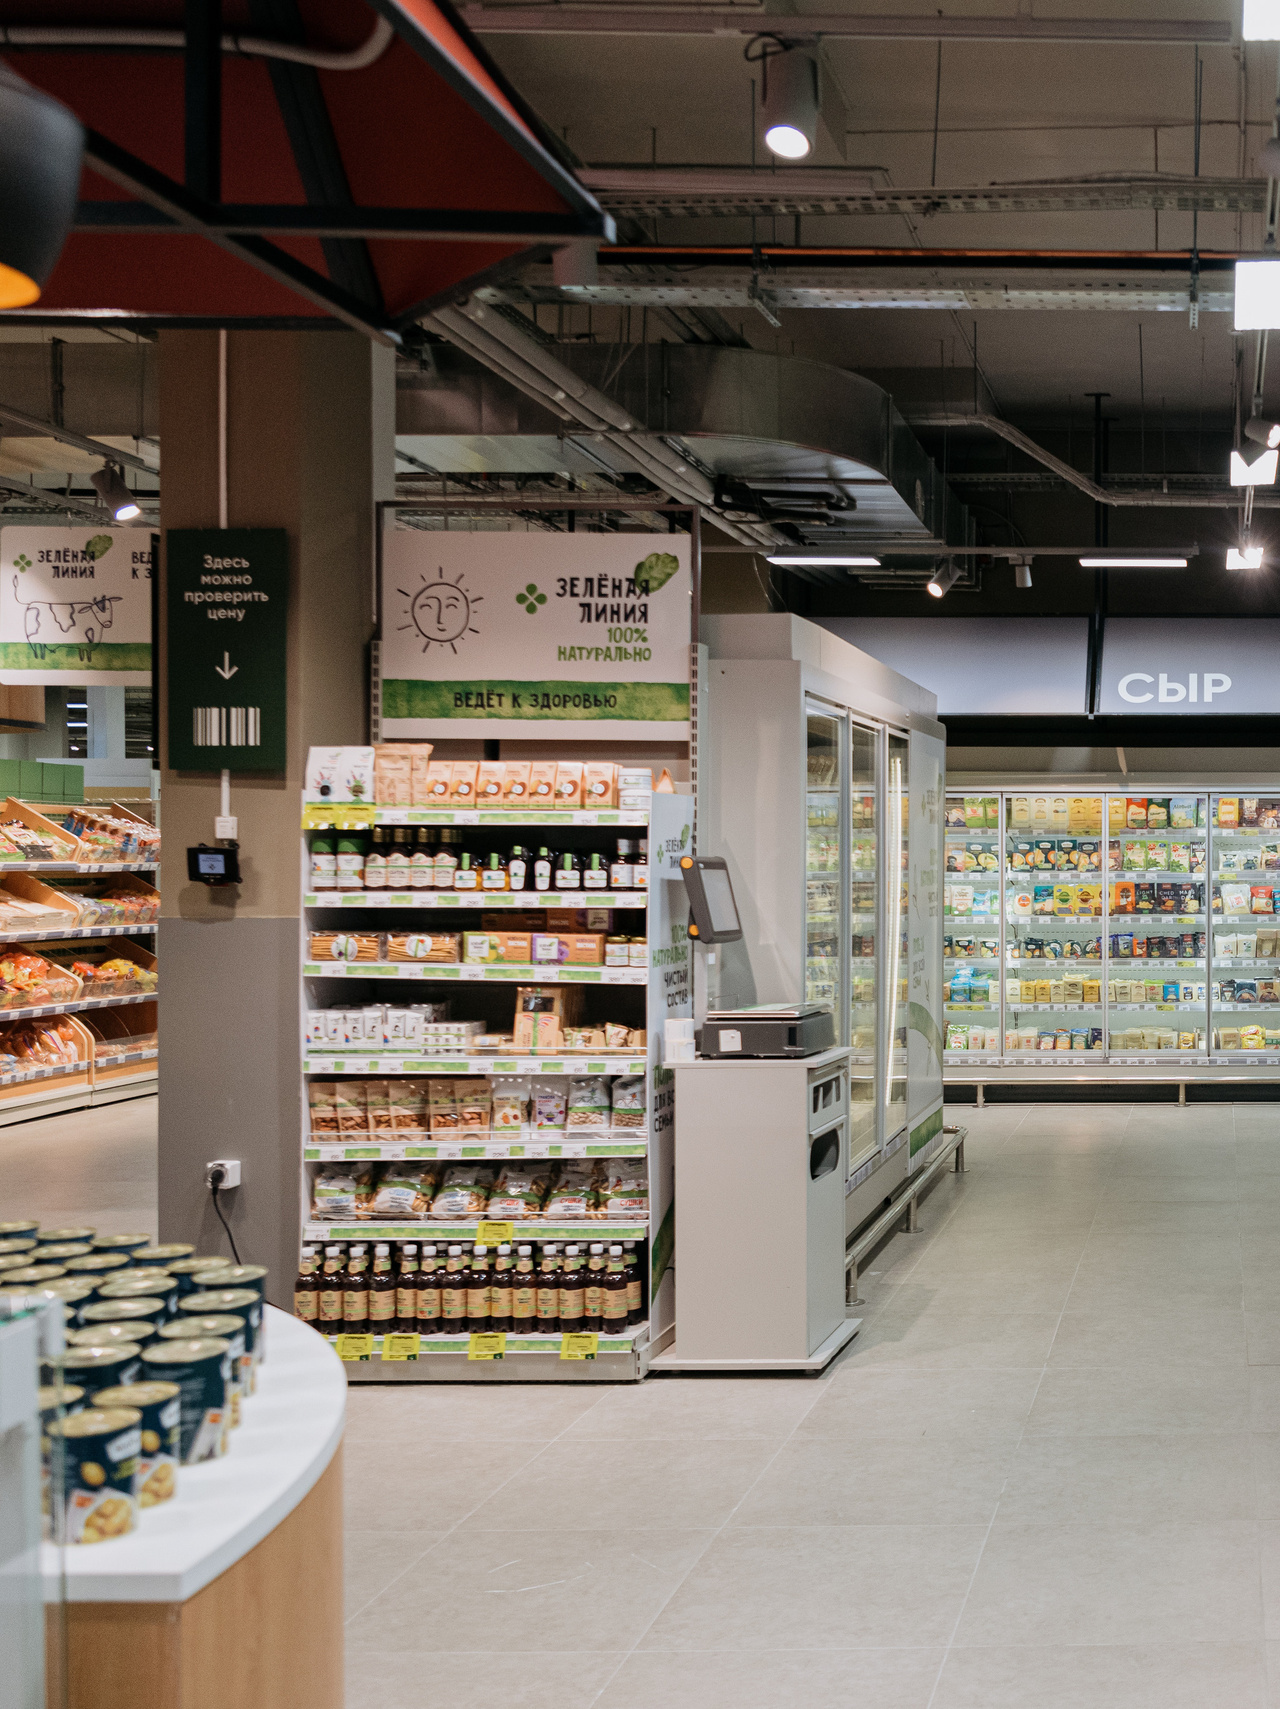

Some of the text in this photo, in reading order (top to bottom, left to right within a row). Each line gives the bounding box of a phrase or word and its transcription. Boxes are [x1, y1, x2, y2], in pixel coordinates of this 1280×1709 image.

[37, 547, 96, 564] ЗЕЛЁНАЯ
[131, 551, 152, 565] ВЕД
[203, 553, 250, 570] Здесь
[52, 565, 96, 579] ЛИНИЯ
[200, 573, 253, 585] можно
[555, 573, 650, 600] ЗЕЛЁНАЯ
[184, 590, 270, 605] проверить
[207, 607, 246, 622] цену
[579, 602, 649, 624] ЛИНИЯ
[607, 626, 649, 644] 100%
[557, 645, 652, 662] НАТУРАЛЬНО
[1117, 672, 1233, 704] СЫР
[453, 689, 618, 711] ВЕДЁТ К ЗДОРОВЬЮ
[620, 1198, 643, 1206] СУШКИ
